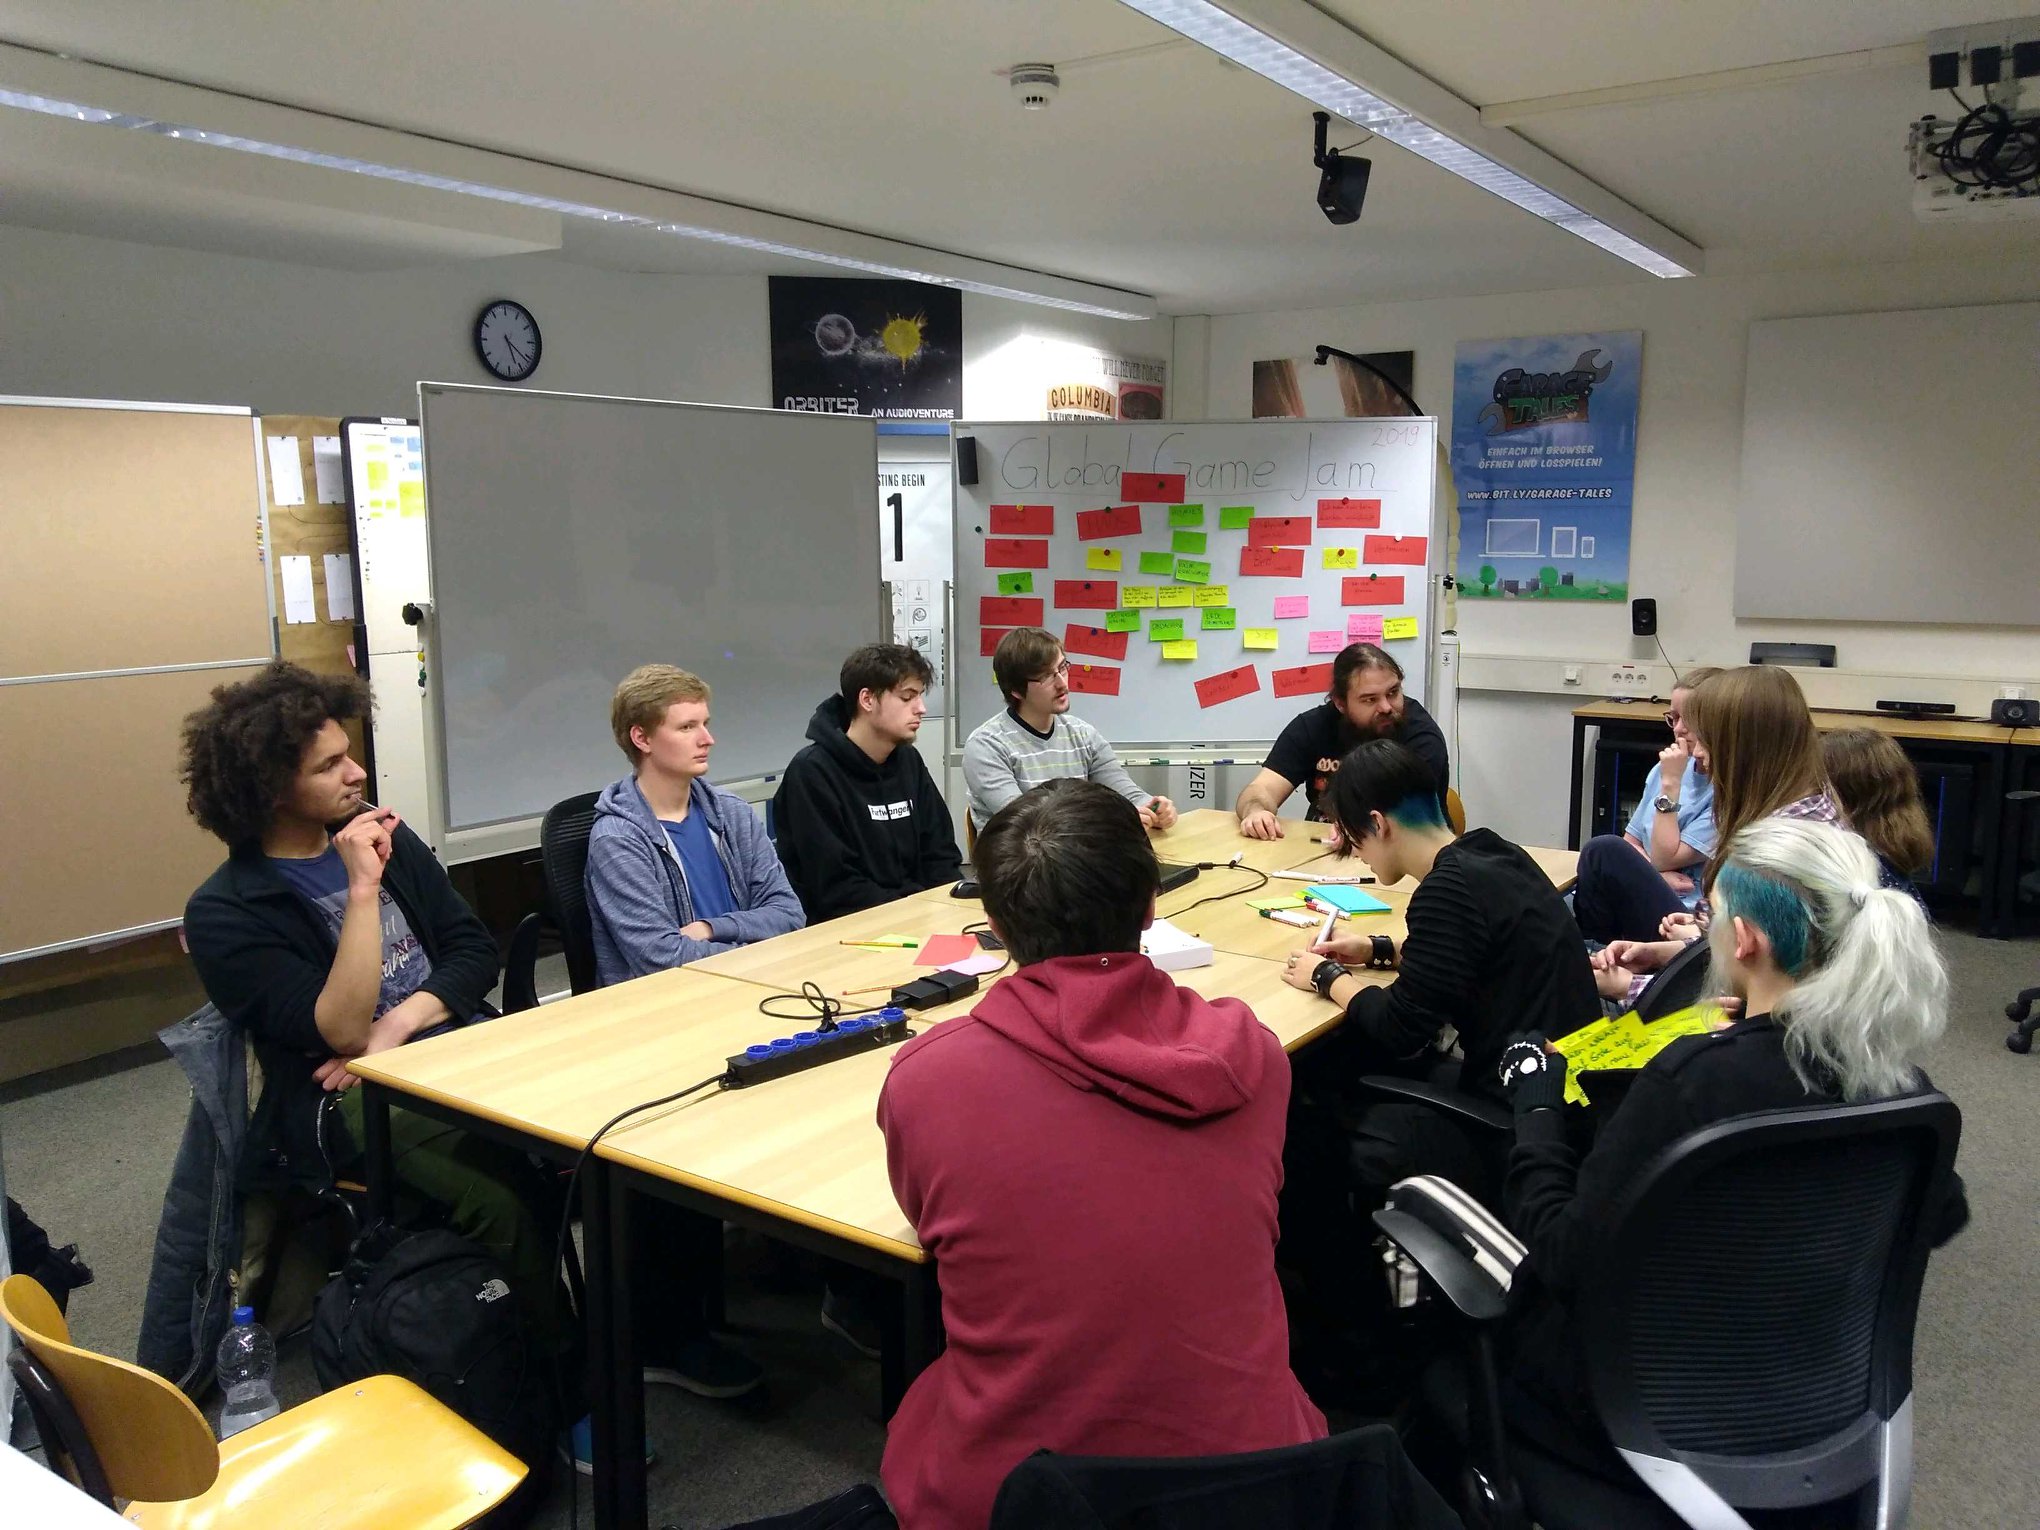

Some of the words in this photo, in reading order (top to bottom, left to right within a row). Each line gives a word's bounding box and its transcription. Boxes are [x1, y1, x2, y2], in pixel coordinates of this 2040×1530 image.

[784, 397, 859, 415] ORBITER
[1051, 386, 1111, 415] COLUMBIA
[1507, 394, 1579, 424] TALES
[871, 408, 884, 418] AN
[886, 408, 955, 418] AUDIOVENTURE
[1371, 425, 1419, 447] 2019
[1487, 447, 1527, 456] EINFACH
[1530, 447, 1541, 456] IM
[1546, 445, 1595, 455] BROWSER
[1001, 433, 1132, 490] Global
[1154, 433, 1276, 489] Game
[1291, 433, 1376, 500] Jam
[1478, 458, 1514, 469] ÖFFNEN
[1517, 459, 1538, 468] UND
[1541, 457, 1603, 468] LOSSPIELEN!
[902, 474, 925, 486] BEGIN
[887, 493, 903, 561] 1
